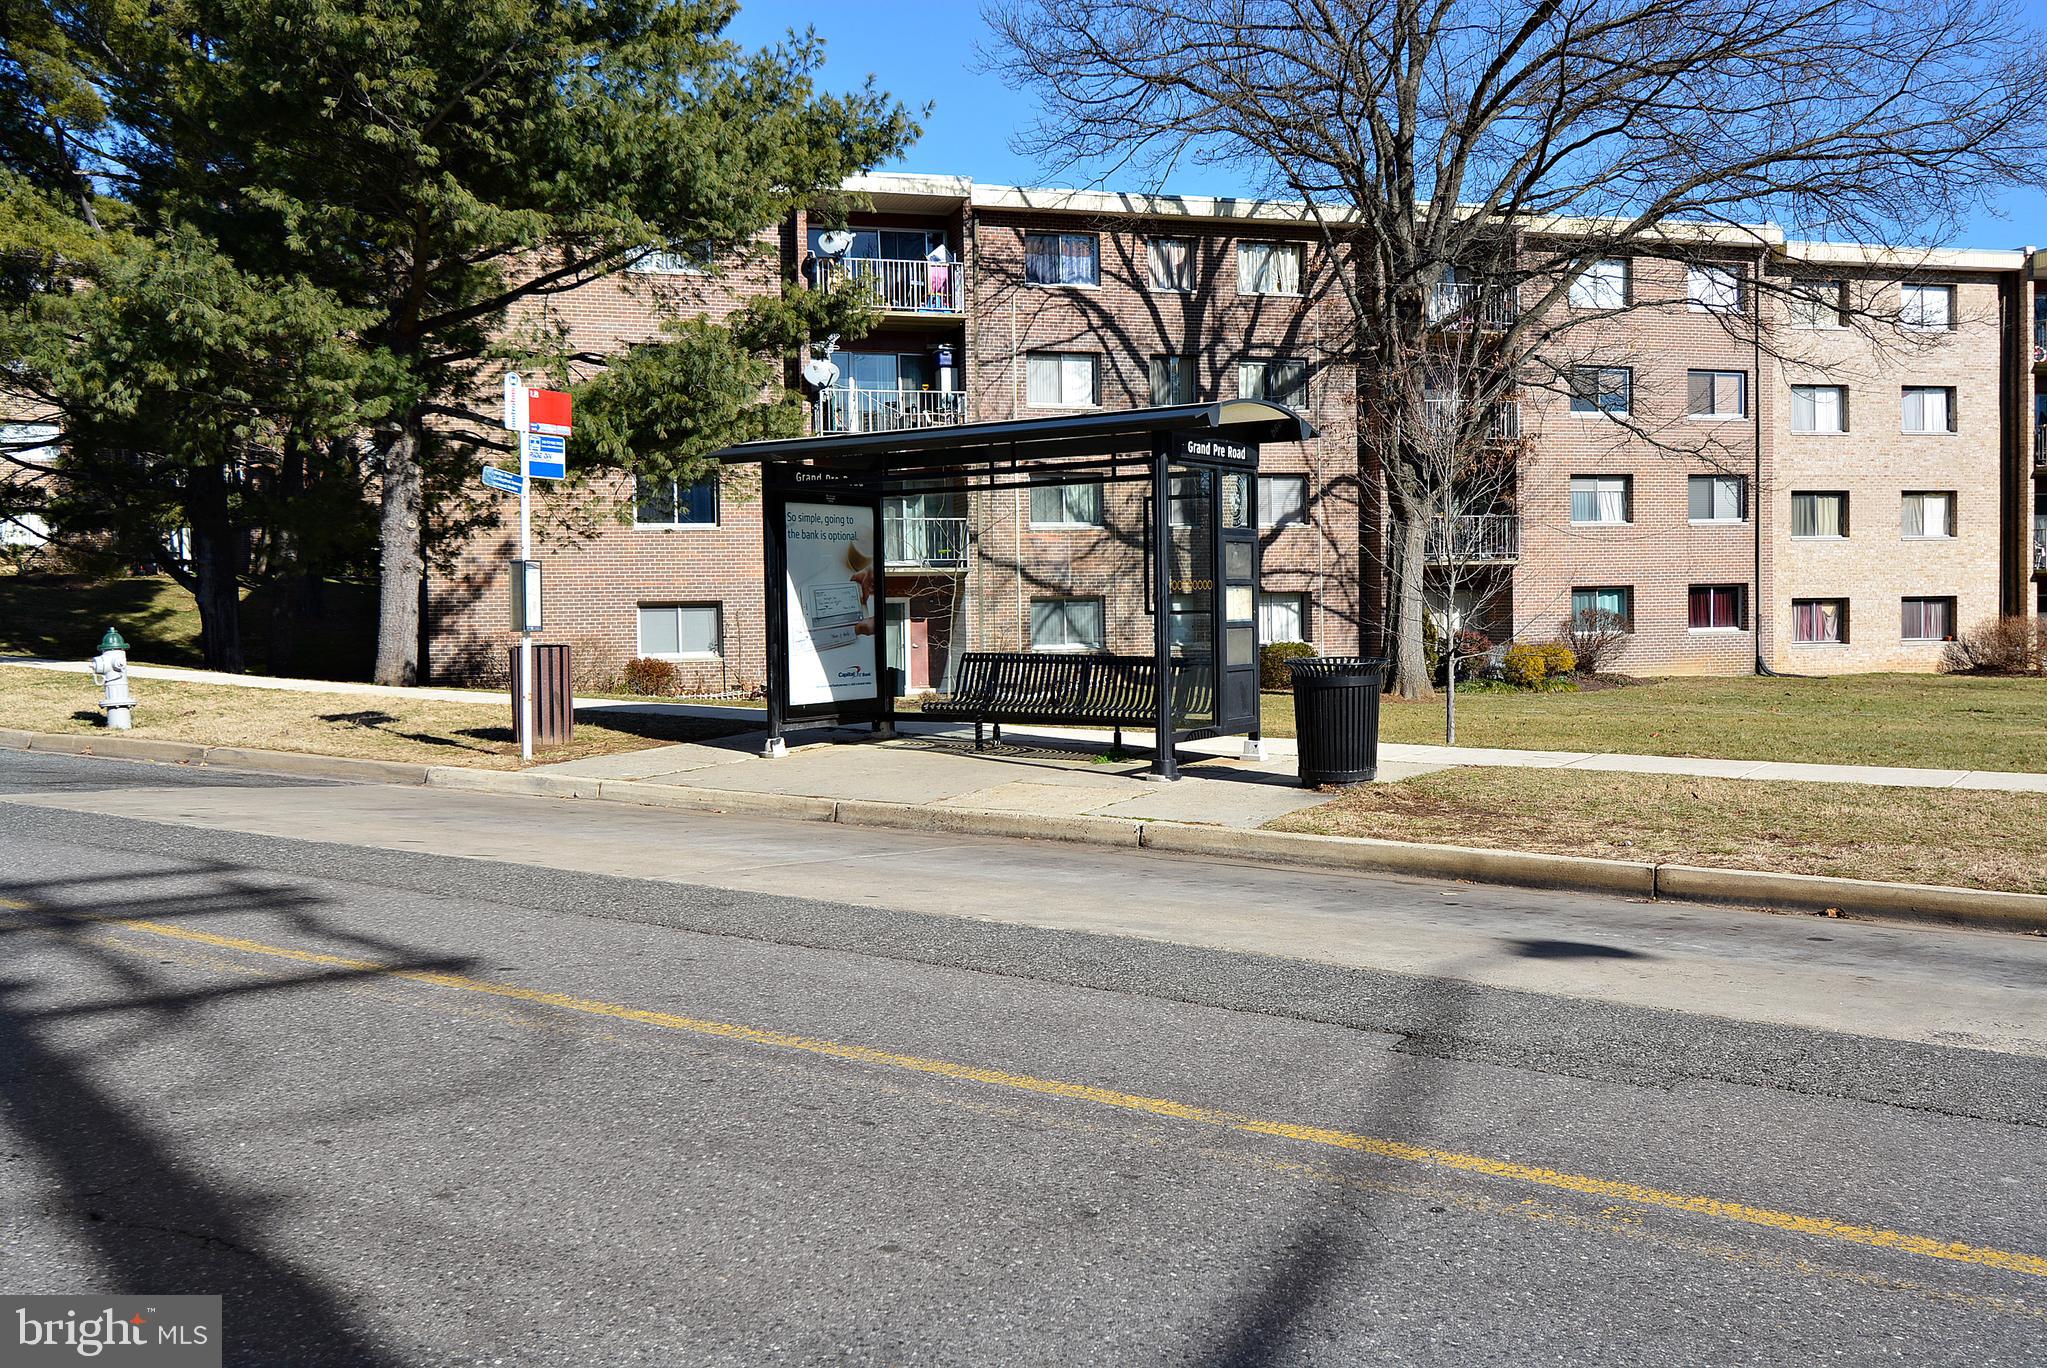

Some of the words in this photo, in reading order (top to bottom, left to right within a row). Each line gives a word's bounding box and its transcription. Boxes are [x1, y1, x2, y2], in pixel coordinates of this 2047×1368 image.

[1188, 440, 1210, 455] Grand
[1213, 443, 1225, 457] Pre
[1228, 445, 1246, 459] Road
[796, 471, 822, 482] Grand
[787, 511, 796, 522] So
[798, 512, 823, 524] simple,
[824, 514, 845, 526] going
[846, 515, 854, 524] to
[787, 529, 800, 539] the
[801, 529, 819, 540] bank
[820, 530, 827, 540] is
